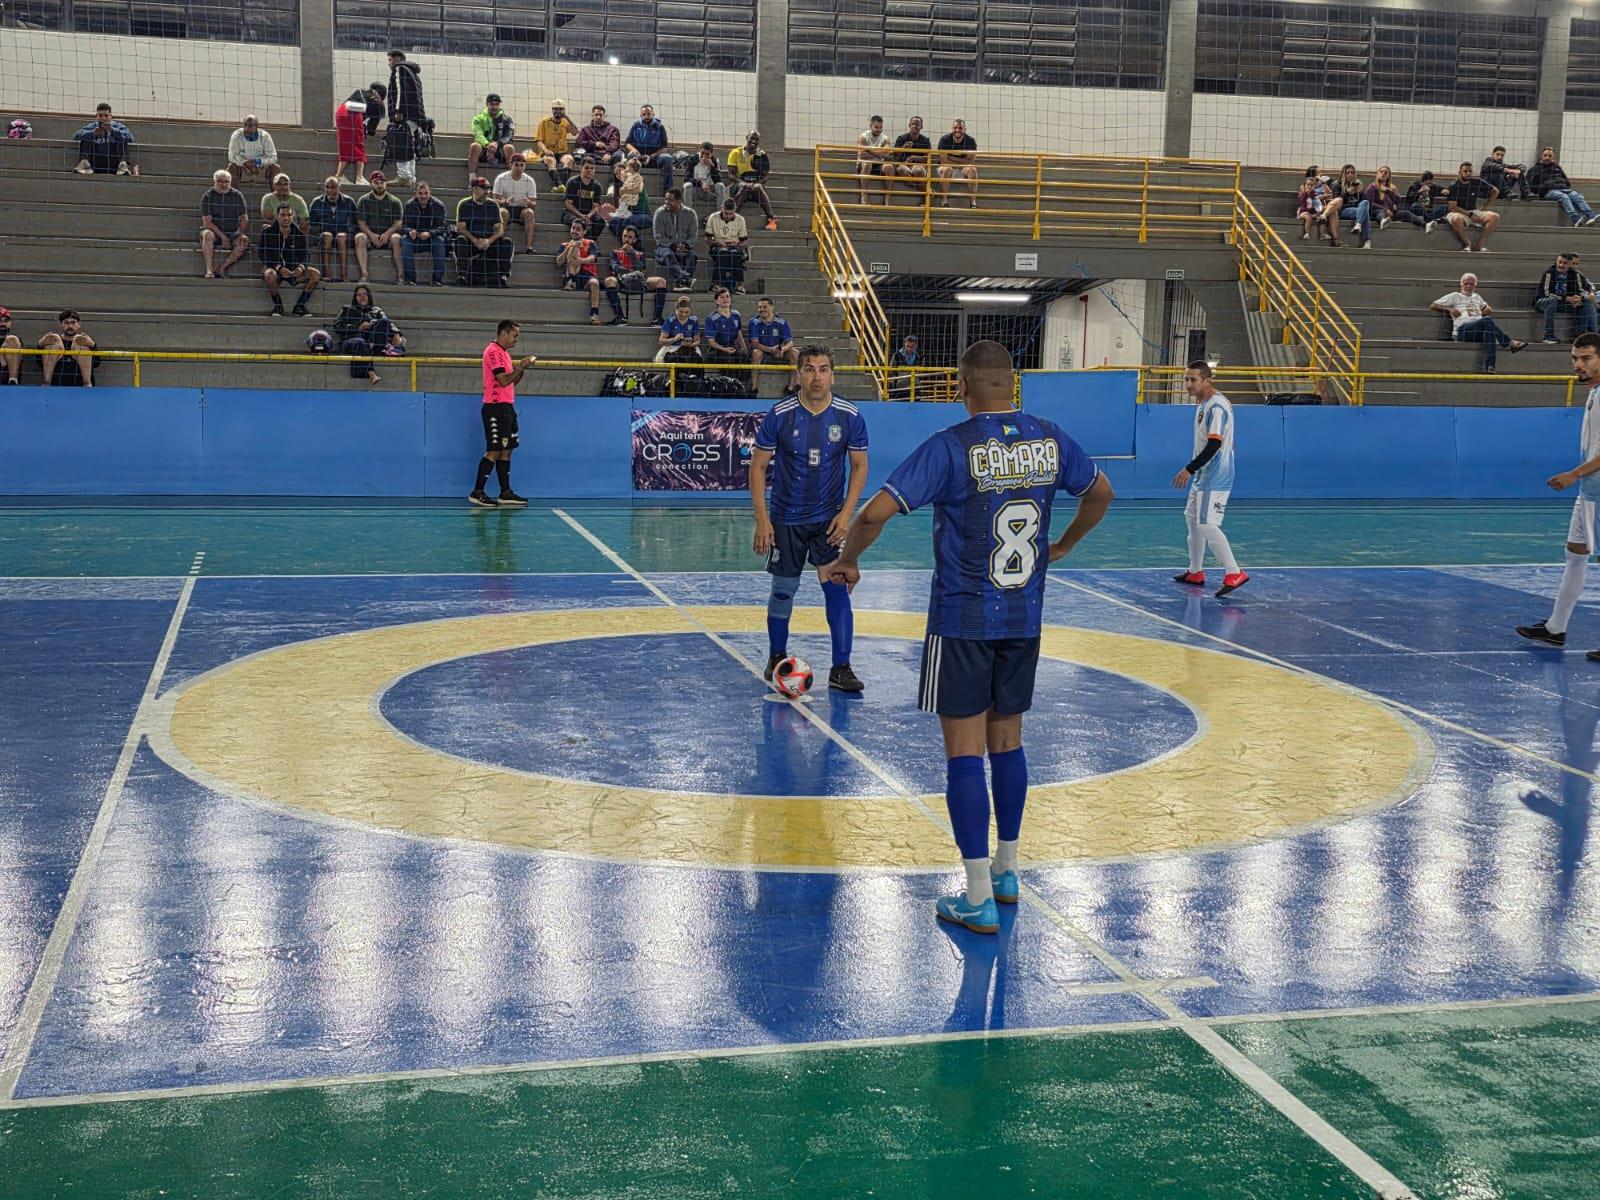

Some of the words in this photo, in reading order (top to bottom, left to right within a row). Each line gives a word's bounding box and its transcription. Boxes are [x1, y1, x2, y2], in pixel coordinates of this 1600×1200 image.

[660, 431, 682, 441] Aqui
[684, 432, 704, 440] tem
[642, 442, 720, 462] CROSS
[809, 448, 820, 467] 5
[971, 440, 1058, 477] CÂMARA
[655, 462, 709, 470] conection
[990, 499, 1041, 588] 8
